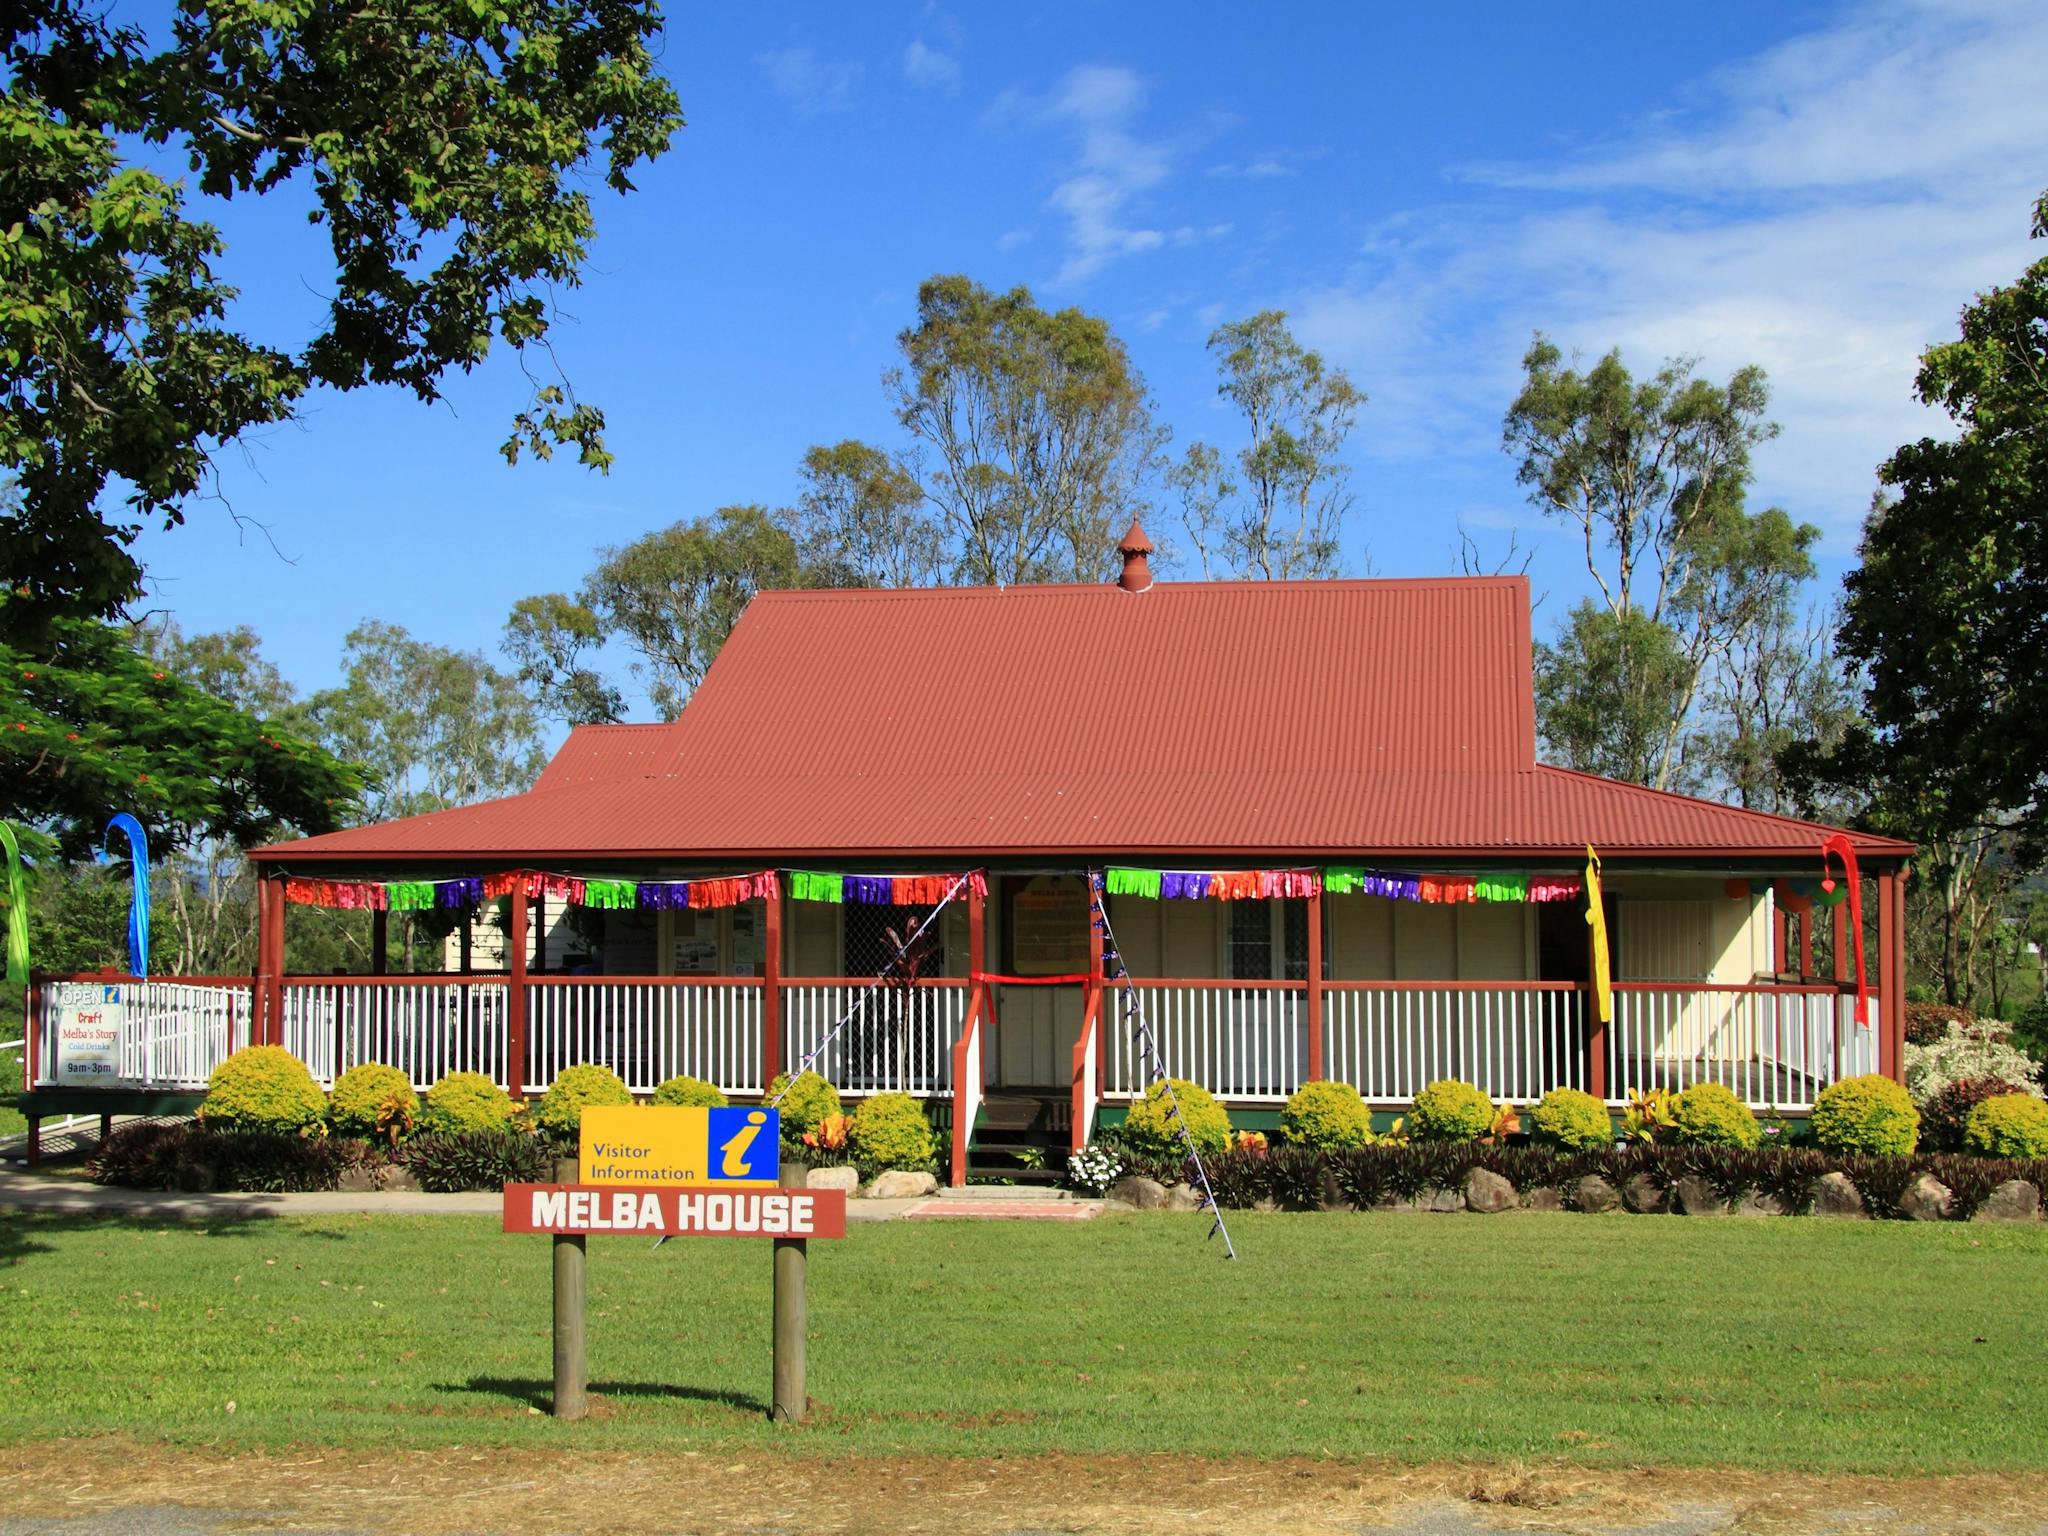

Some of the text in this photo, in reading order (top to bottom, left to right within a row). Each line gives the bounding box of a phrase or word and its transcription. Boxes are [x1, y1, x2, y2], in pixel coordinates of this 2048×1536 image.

[62, 990, 102, 1006] OPEN
[78, 1011, 103, 1024] Craft
[63, 1028, 117, 1042] Melba's Story
[68, 1042, 110, 1050] Cold Drinks
[593, 1143, 652, 1158] Visitor
[592, 1164, 695, 1180] Information
[531, 1191, 814, 1234] MELBA HOUSE
